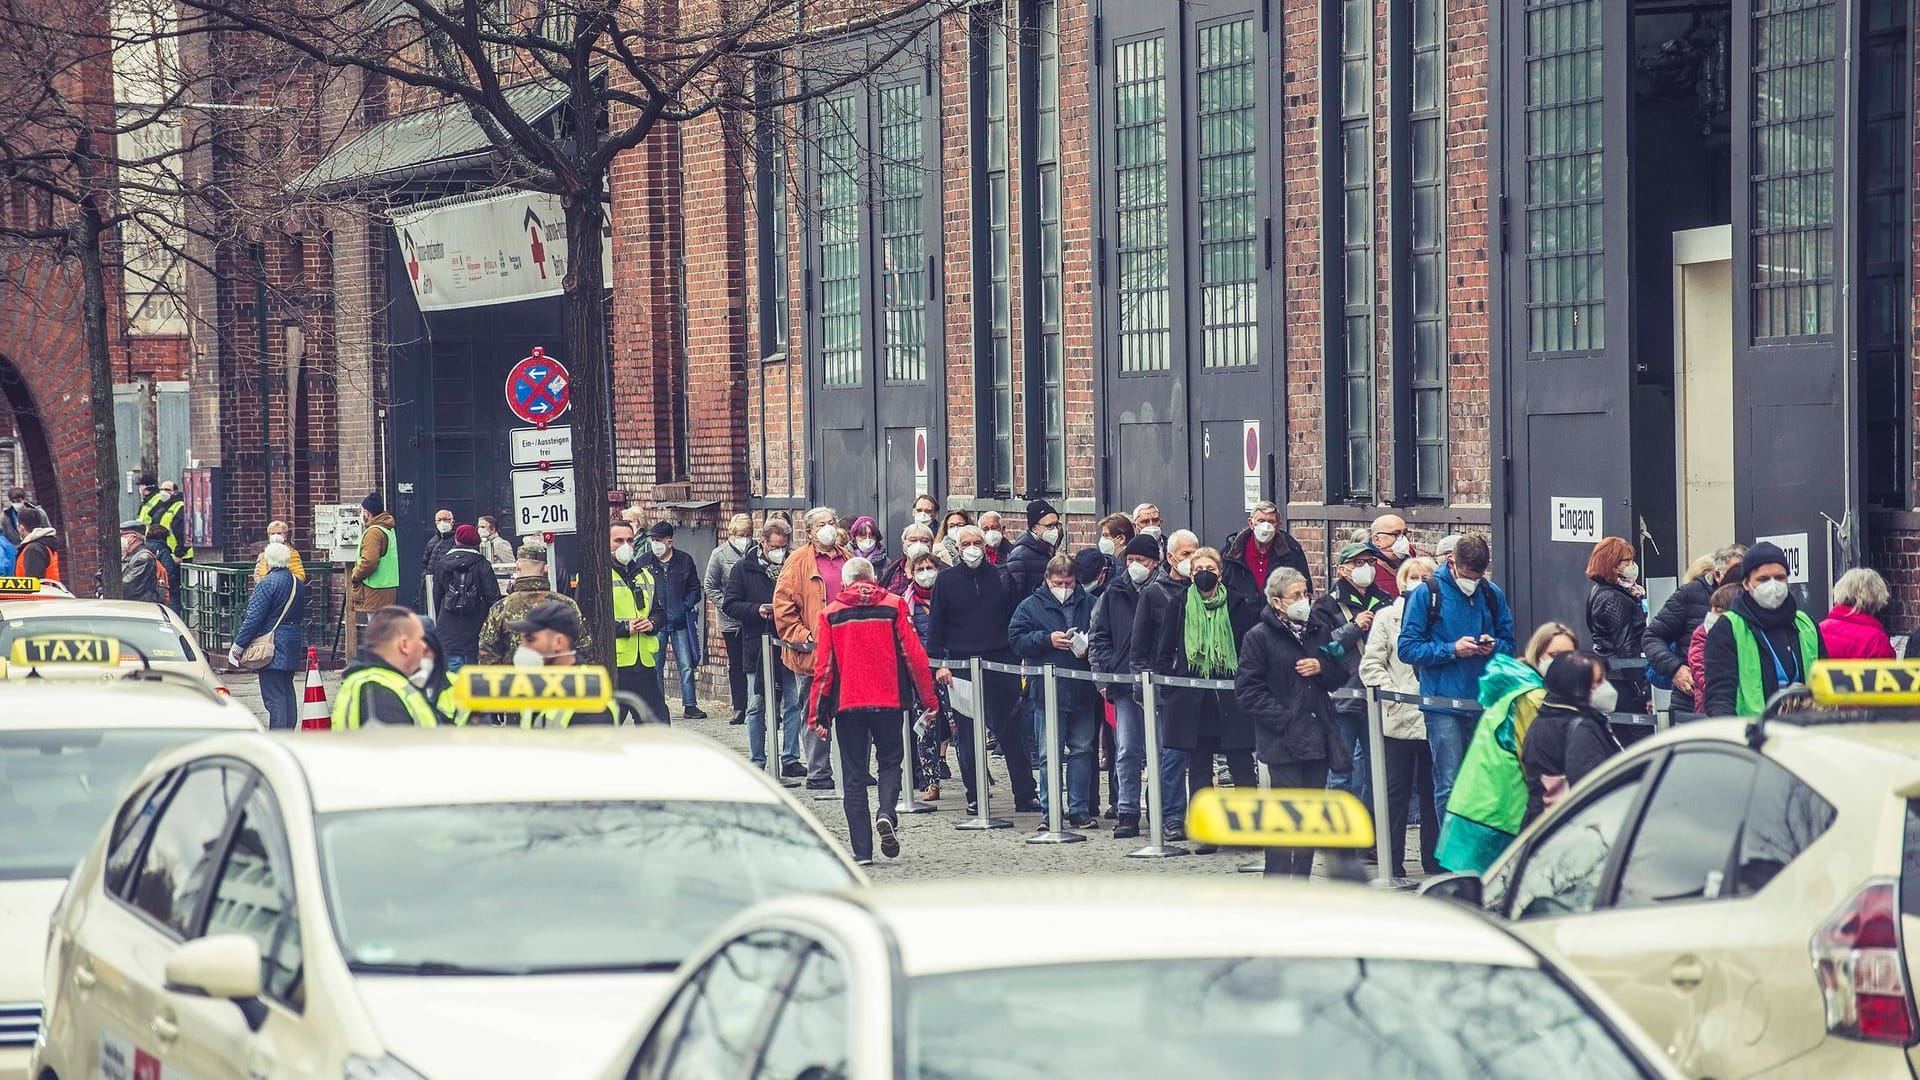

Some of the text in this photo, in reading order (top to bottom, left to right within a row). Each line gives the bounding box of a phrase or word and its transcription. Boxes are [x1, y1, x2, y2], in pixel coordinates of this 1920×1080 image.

[540, 448, 551, 456] frei
[1559, 502, 1595, 537] Eingang
[32, 640, 103, 661] TAXI
[481, 673, 587, 698] TAXI
[1224, 800, 1350, 834] TAXI
